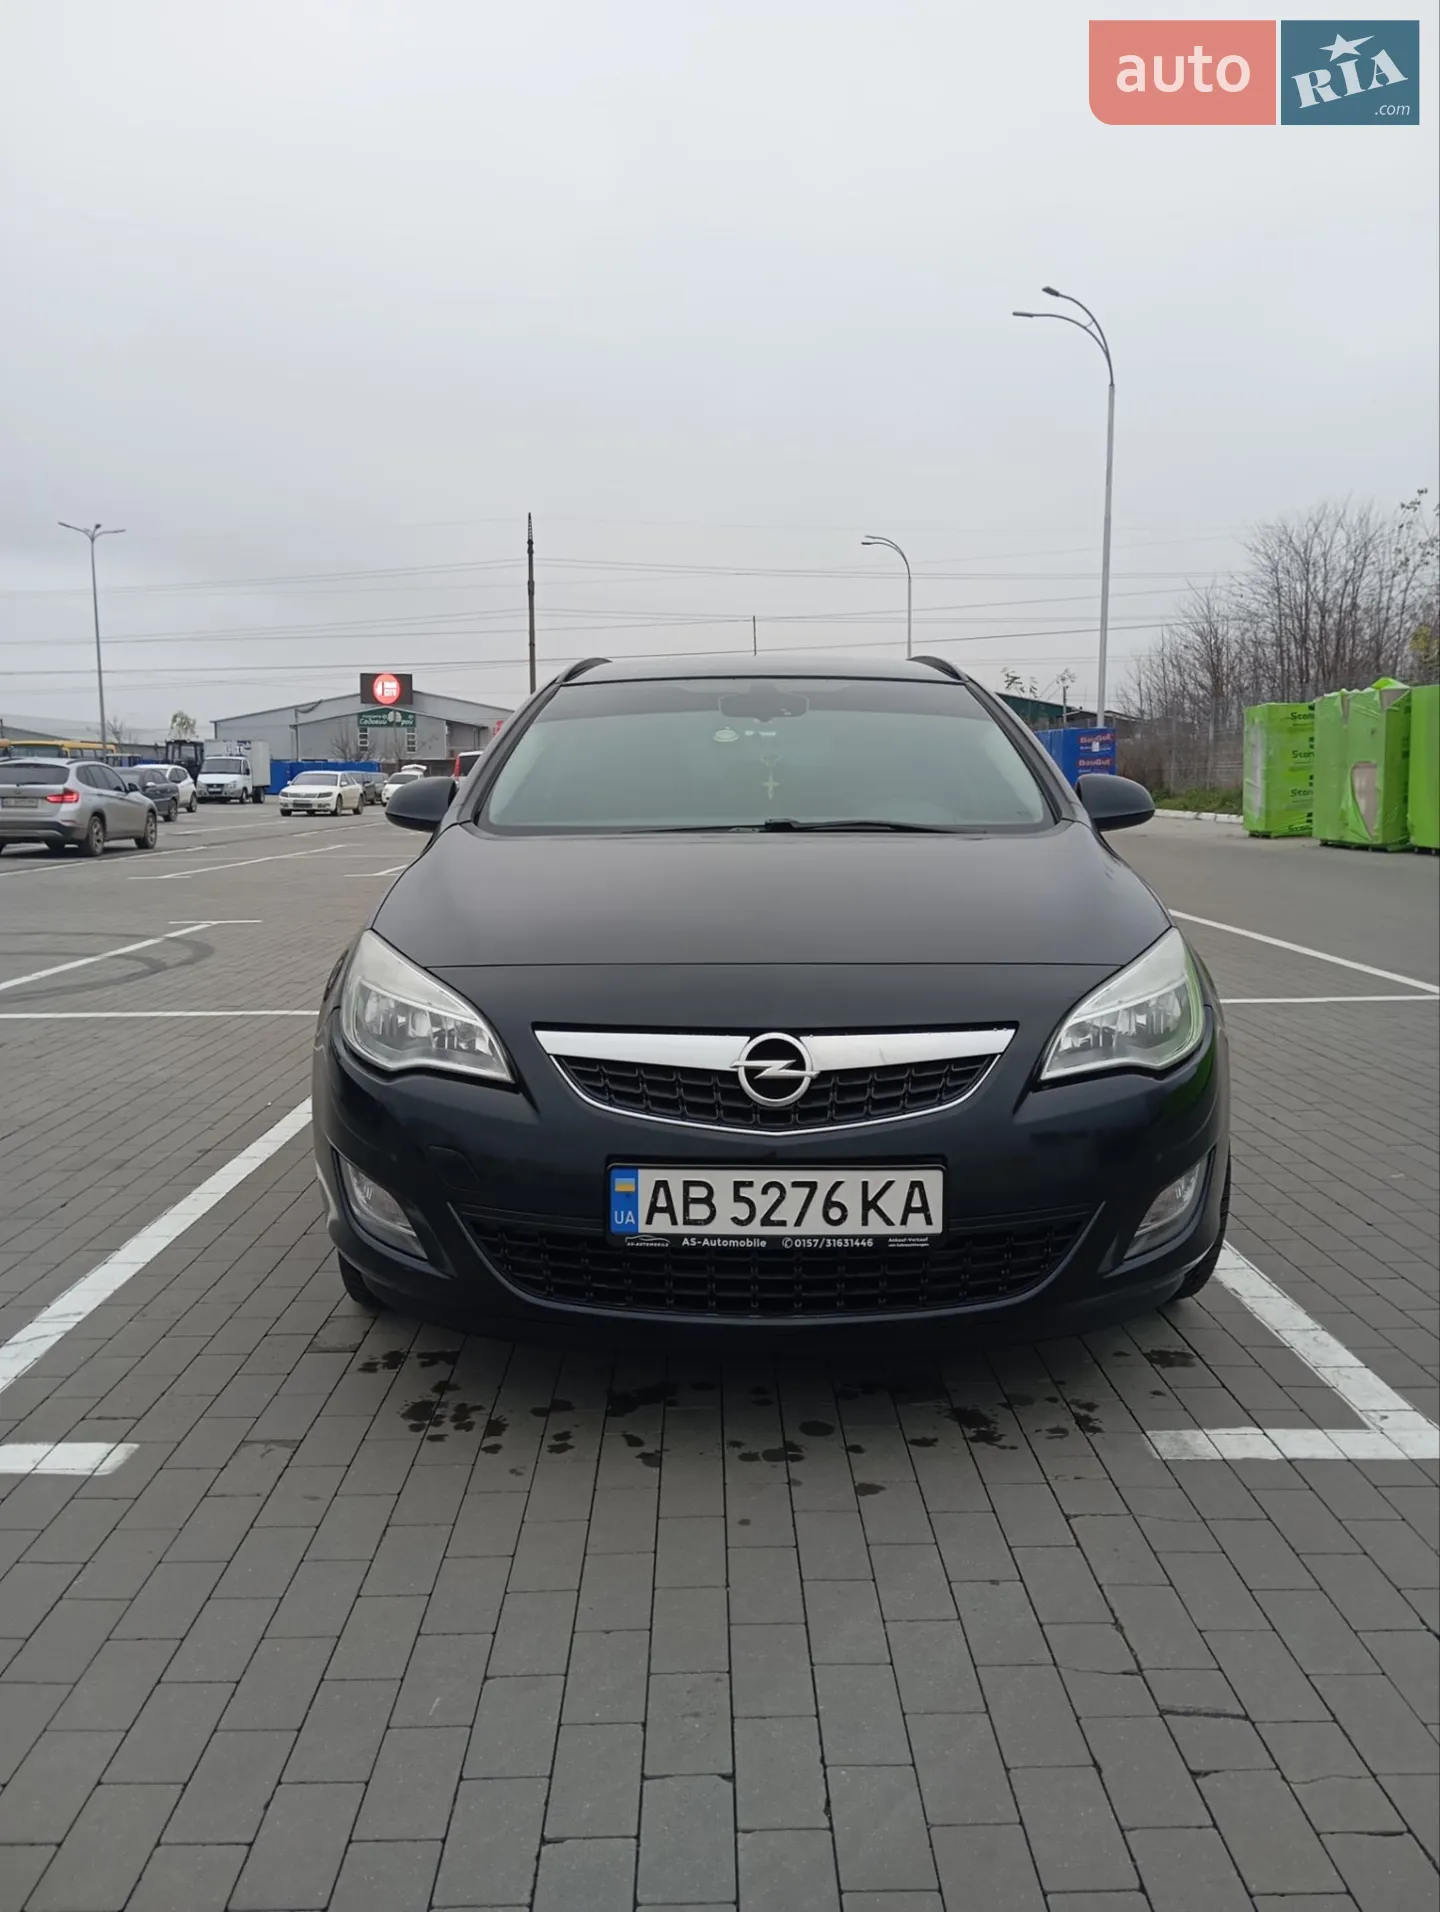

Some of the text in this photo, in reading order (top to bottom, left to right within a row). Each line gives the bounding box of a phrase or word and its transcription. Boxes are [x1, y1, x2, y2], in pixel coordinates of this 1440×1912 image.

[644, 1180, 934, 1228] AB 5276 KA
[613, 1210, 636, 1226] UA
[681, 1237, 874, 1248] AS-Automobile 0157/31631446
